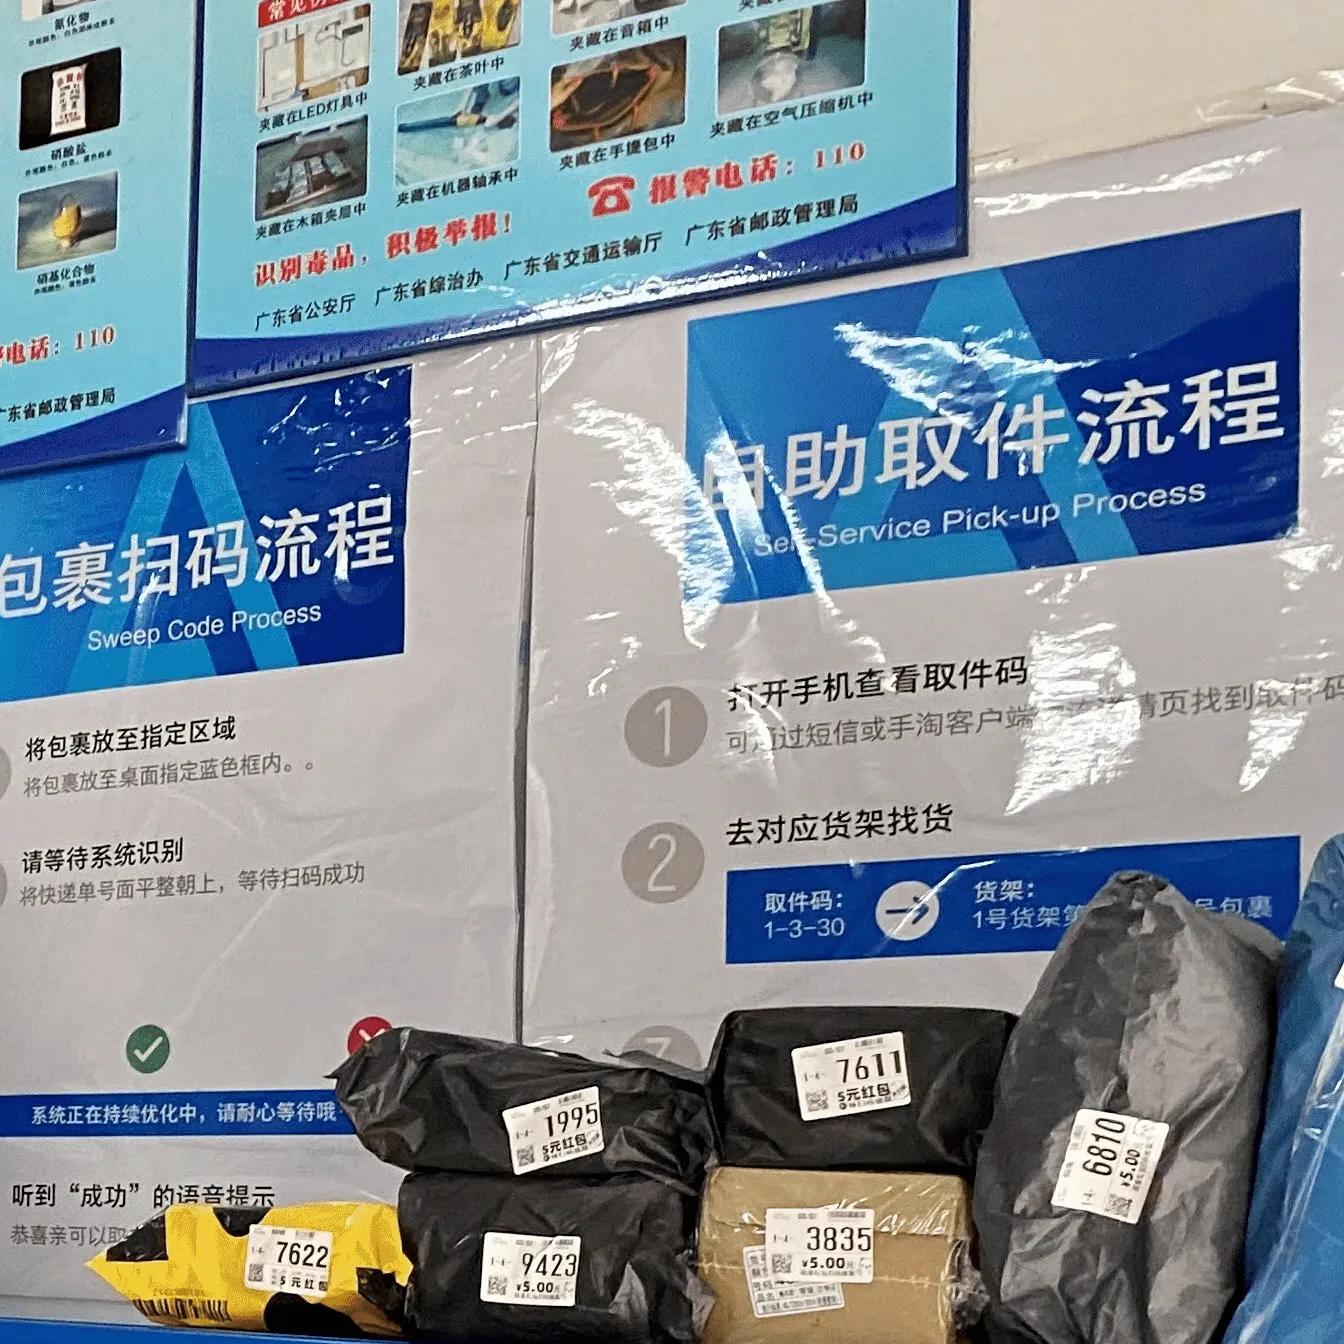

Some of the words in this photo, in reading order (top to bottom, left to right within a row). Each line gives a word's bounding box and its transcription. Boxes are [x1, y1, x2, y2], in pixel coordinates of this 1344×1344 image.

[570, 15, 669, 51] 夹藏在音箱中
[413, 56, 504, 90] 夹藏在茶叶中
[258, 91, 367, 132] 夹藏在LED灯具中
[710, 91, 873, 138] 夹藏在空气压缩机中
[560, 134, 675, 170] 夹藏在手提包中
[815, 142, 865, 169] 110
[396, 167, 517, 207] 夹藏在机器轴承中
[256, 203, 366, 241] 夹藏在木箱夹层中
[254, 292, 356, 331] 广东省公安厅
[374, 269, 484, 306] 广东省综治办
[504, 231, 663, 281] 广东省交通运输厅
[685, 194, 859, 248] 广东省邮政管理局
[74, 325, 115, 353] 110
[943, 500, 1060, 539] Pick-up
[1073, 482, 1206, 518] Process
[88, 624, 160, 652] Sweep
[168, 613, 224, 640] Code
[232, 602, 321, 632] Process
[727, 654, 1028, 713] 打开手机查看取件码
[25, 717, 236, 762] 将包裹放至指定区域
[726, 803, 953, 847] 去对应货架找货
[21, 838, 184, 874] 请等待系统识别
[20, 863, 365, 906] 将快递单号面平整朝上，等待扫码成功
[766, 918, 845, 940] 1-3-30
[836, 1050, 902, 1083] 7611
[838, 1082, 891, 1102] 5元红包
[545, 1103, 597, 1137] 1995
[542, 1133, 586, 1154] 5元红包
[1082, 1116, 1128, 1177] 6810
[276, 1241, 328, 1268] 7622
[806, 1226, 872, 1252] 3835
[522, 1252, 576, 1277] 9423
[802, 1257, 846, 1269] ¥5.00
